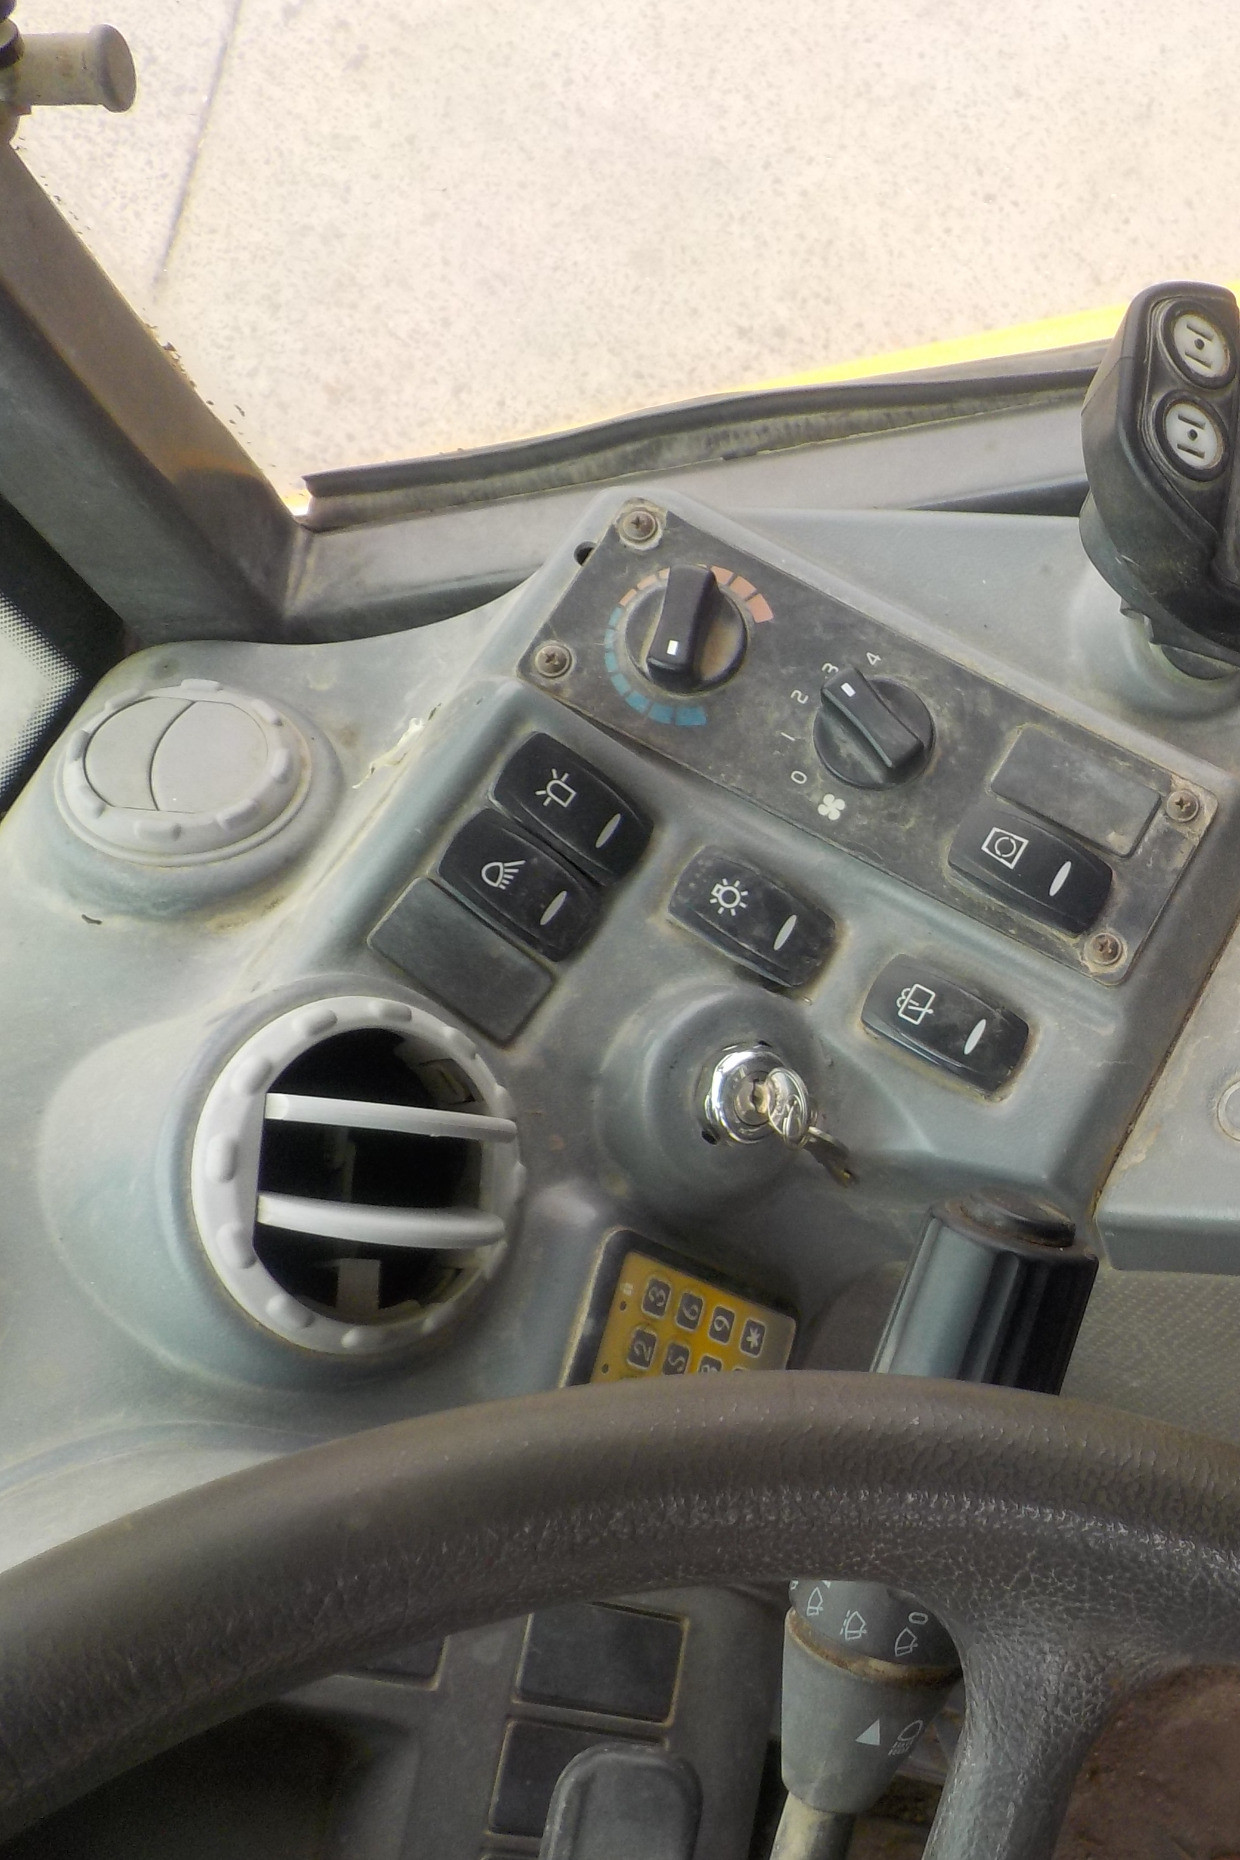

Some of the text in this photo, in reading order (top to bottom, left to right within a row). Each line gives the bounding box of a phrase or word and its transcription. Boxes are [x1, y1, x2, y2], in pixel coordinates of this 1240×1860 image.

[866, 652, 881, 665] 4
[822, 663, 839, 673] 3
[791, 690, 808, 704] 2
[791, 771, 807, 784] 0
[649, 1286, 666, 1306] 3
[683, 1304, 698, 1321] 6
[714, 1316, 730, 1332] 9
[634, 1341, 651, 1361] 2
